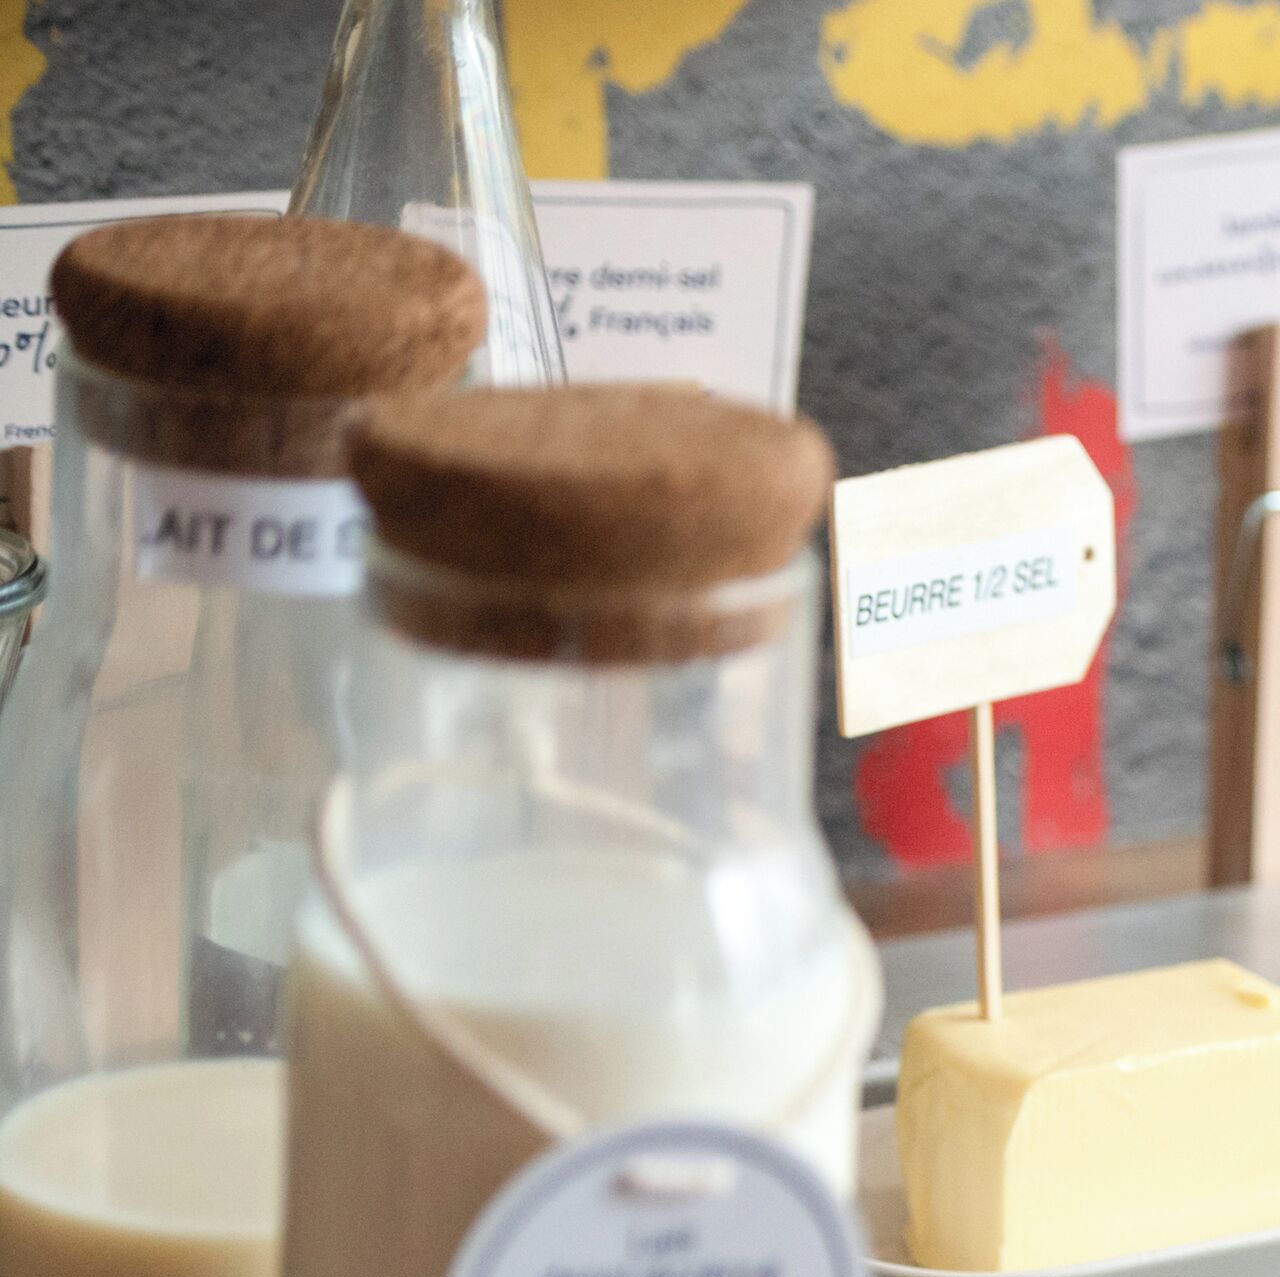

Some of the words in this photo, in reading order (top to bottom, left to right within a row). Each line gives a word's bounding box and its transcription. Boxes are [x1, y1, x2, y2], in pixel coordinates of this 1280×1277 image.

[549, 267, 580, 287] re
[589, 304, 714, 341] Français
[140, 508, 232, 557] AIT
[250, 517, 319, 561] DE
[855, 573, 965, 627] BEURRE
[973, 563, 1008, 602] 1/2
[1012, 555, 1058, 594] SEL
